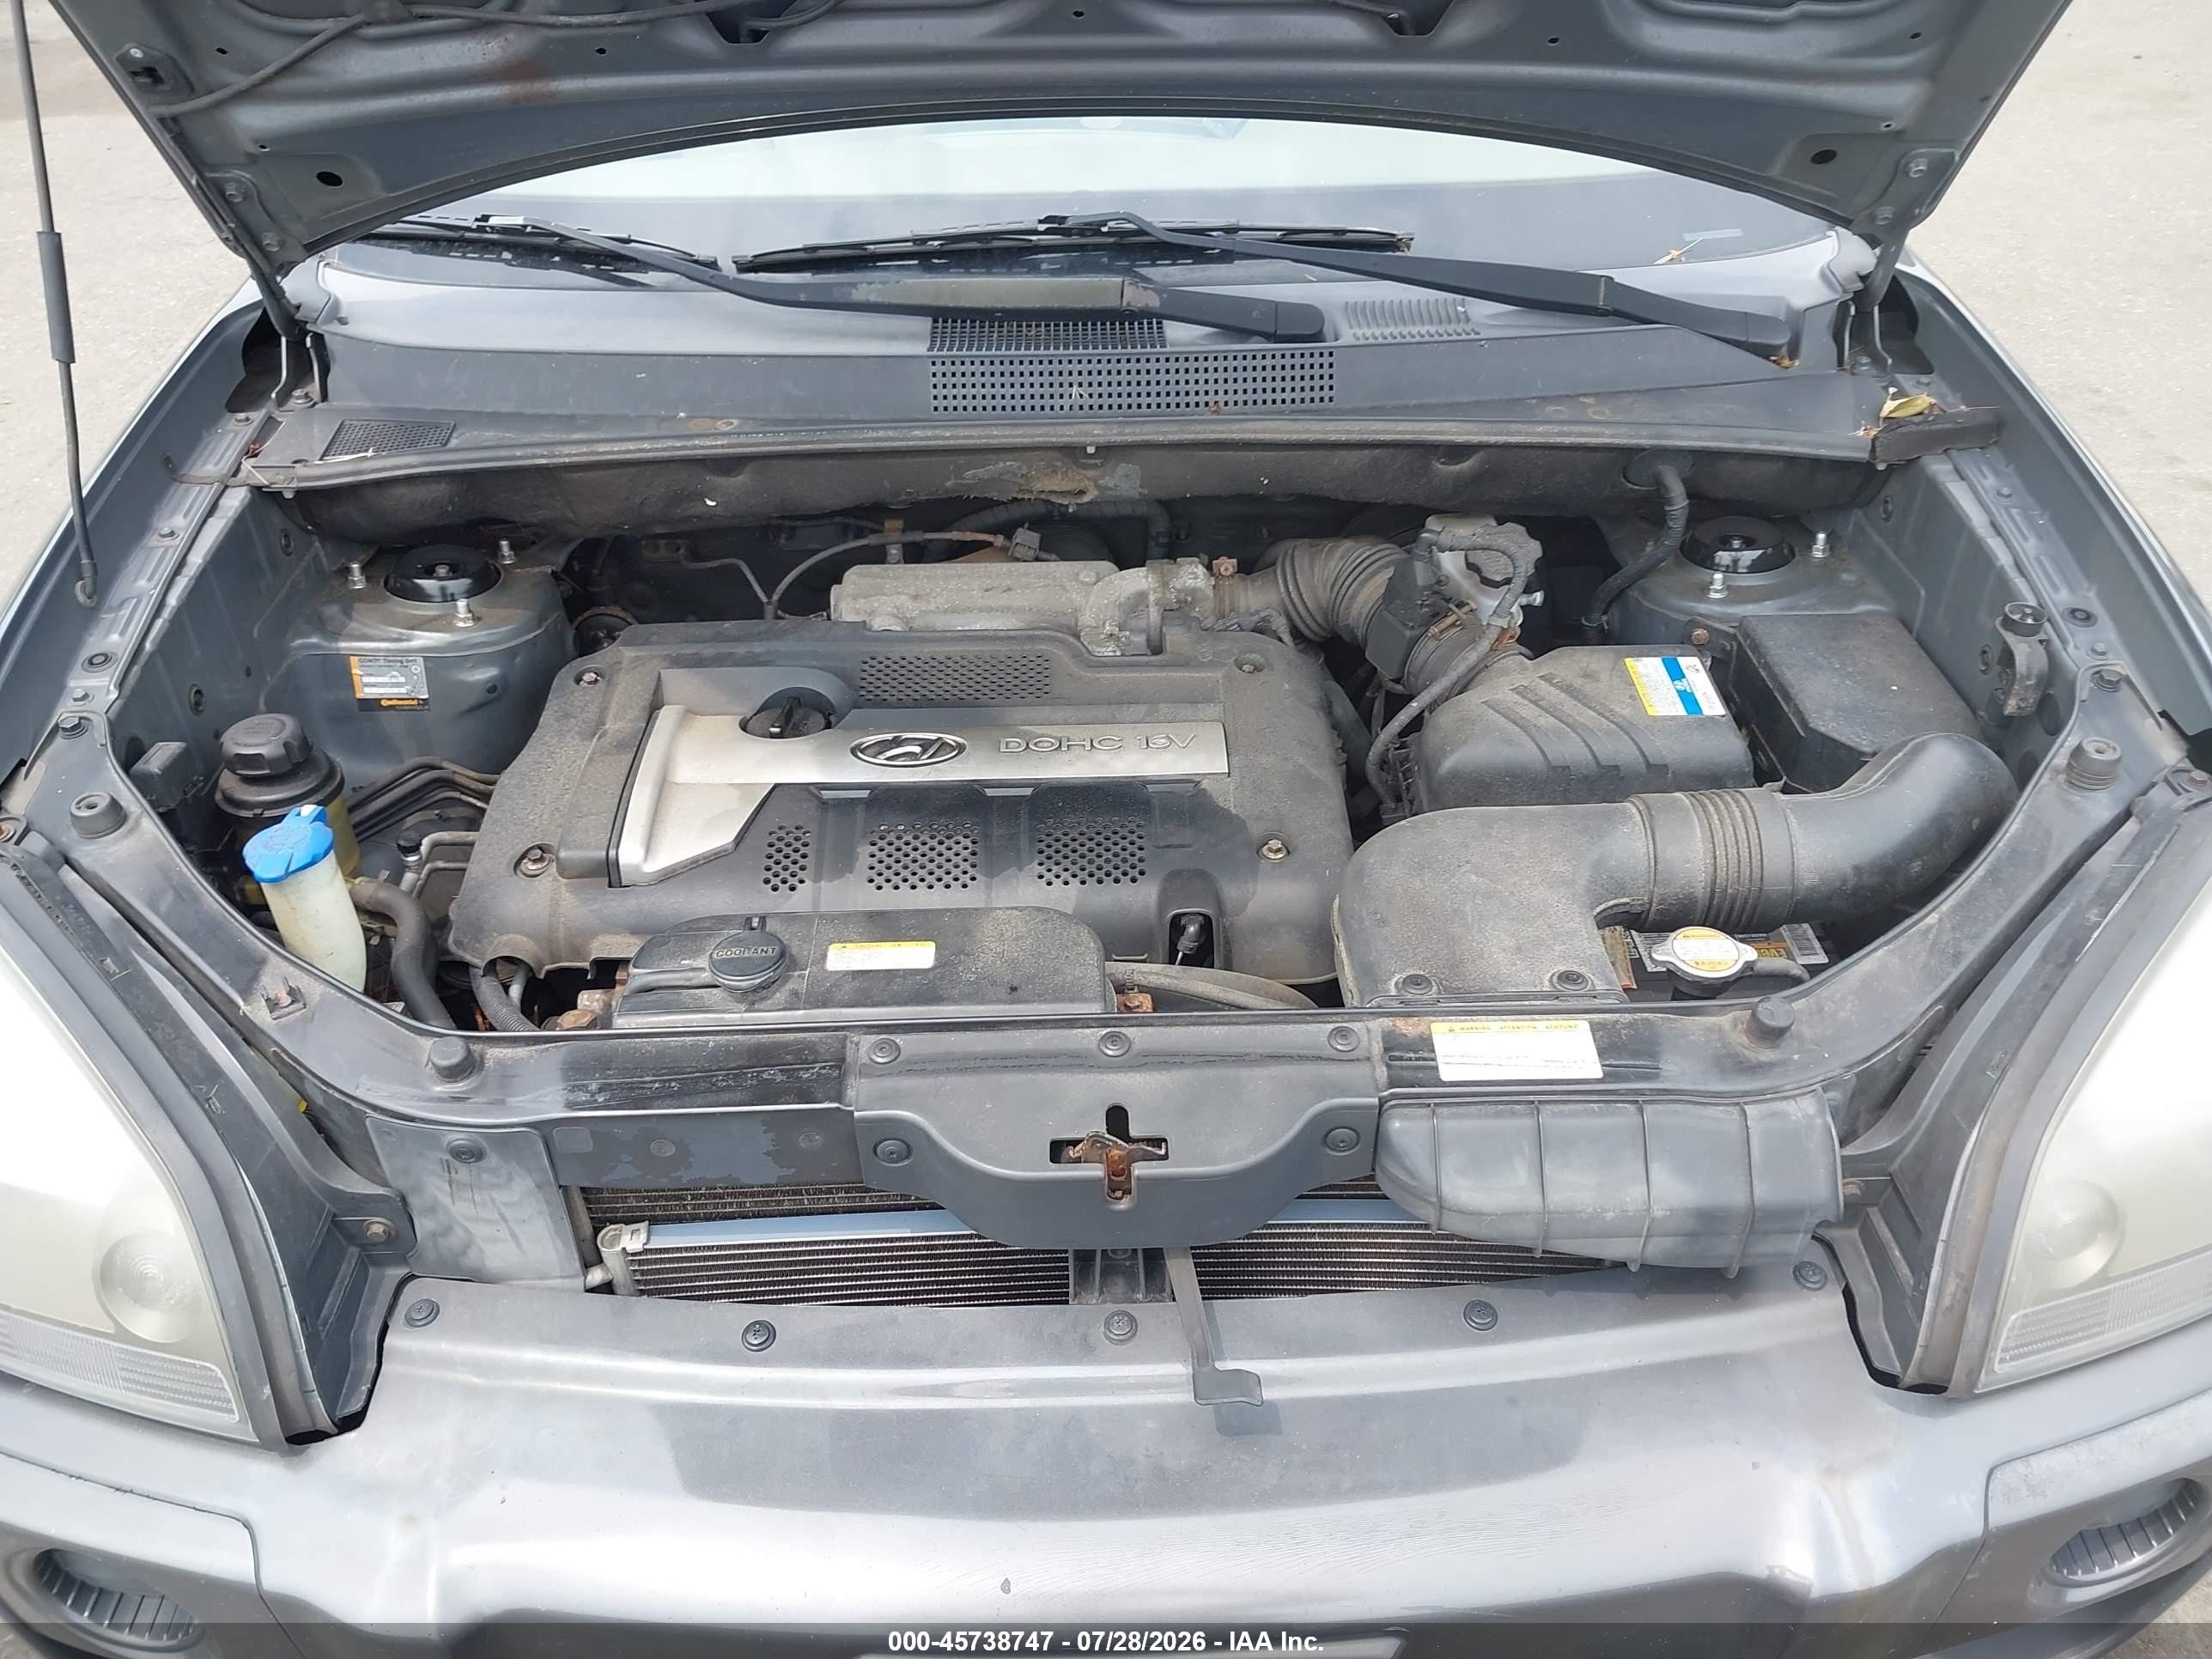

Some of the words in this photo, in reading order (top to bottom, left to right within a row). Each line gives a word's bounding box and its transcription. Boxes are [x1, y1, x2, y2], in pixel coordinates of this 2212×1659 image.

[999, 735, 1123, 753] DOHC
[1136, 733, 1197, 750] 16V
[714, 946, 779, 958] COOLANT
